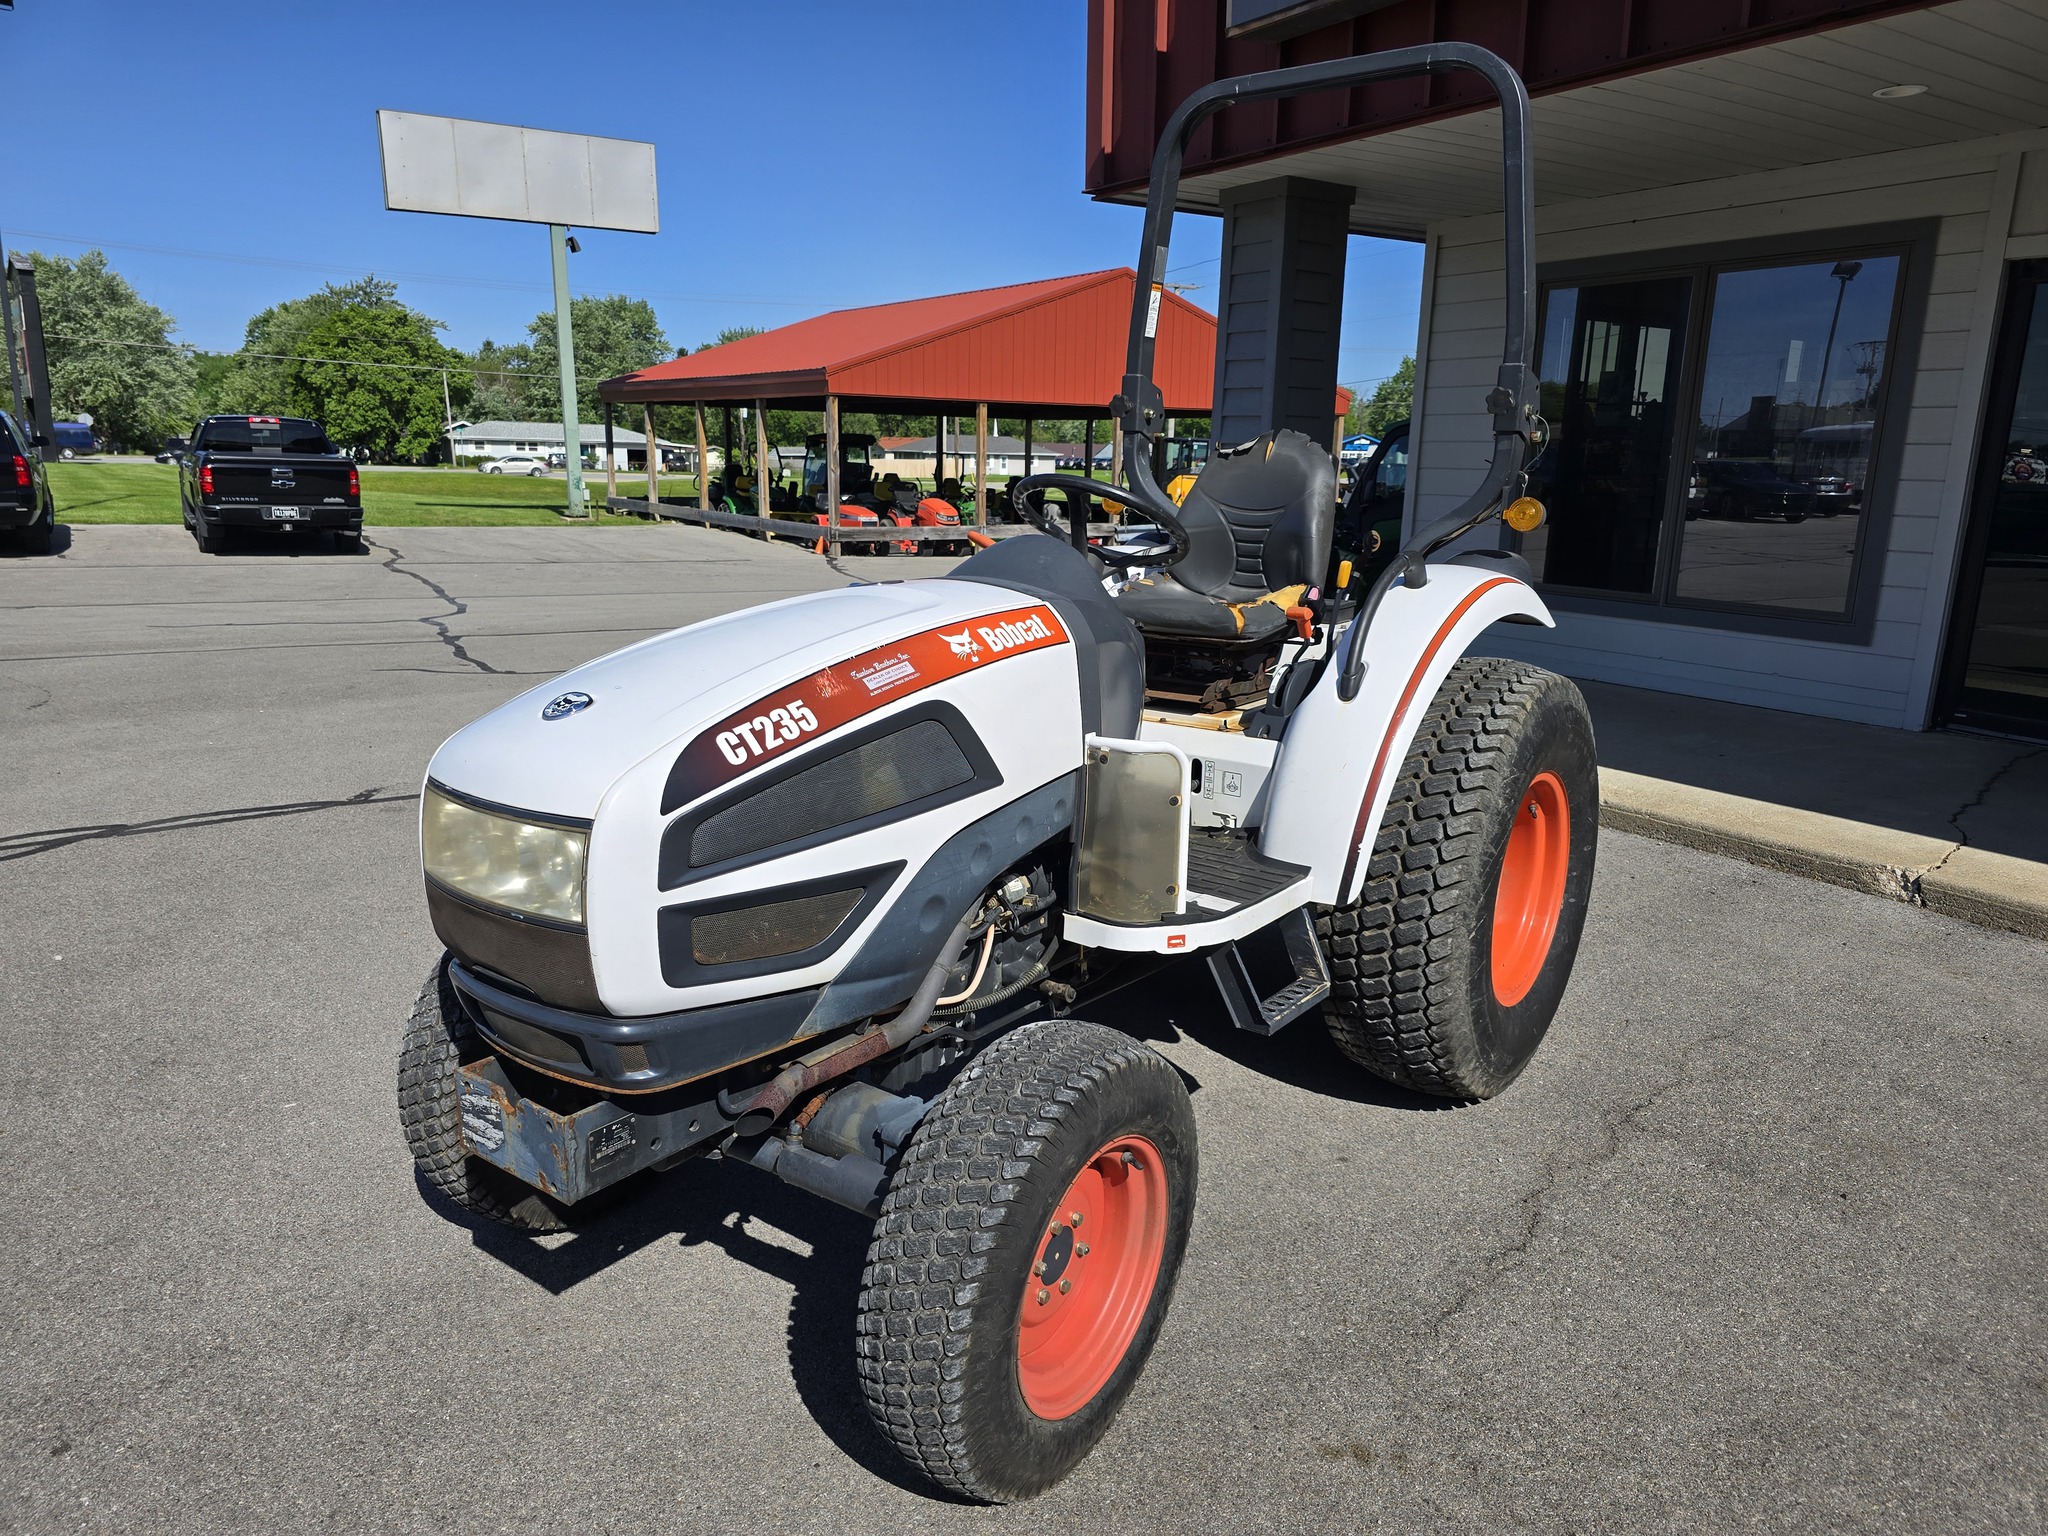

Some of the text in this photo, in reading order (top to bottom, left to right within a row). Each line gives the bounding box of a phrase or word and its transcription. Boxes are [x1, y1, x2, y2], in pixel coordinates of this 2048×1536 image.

[976, 614, 1052, 653] Bobcat
[866, 673, 885, 683] DEALER
[891, 663, 909, 673] CHOICE
[715, 699, 819, 767] CT235
